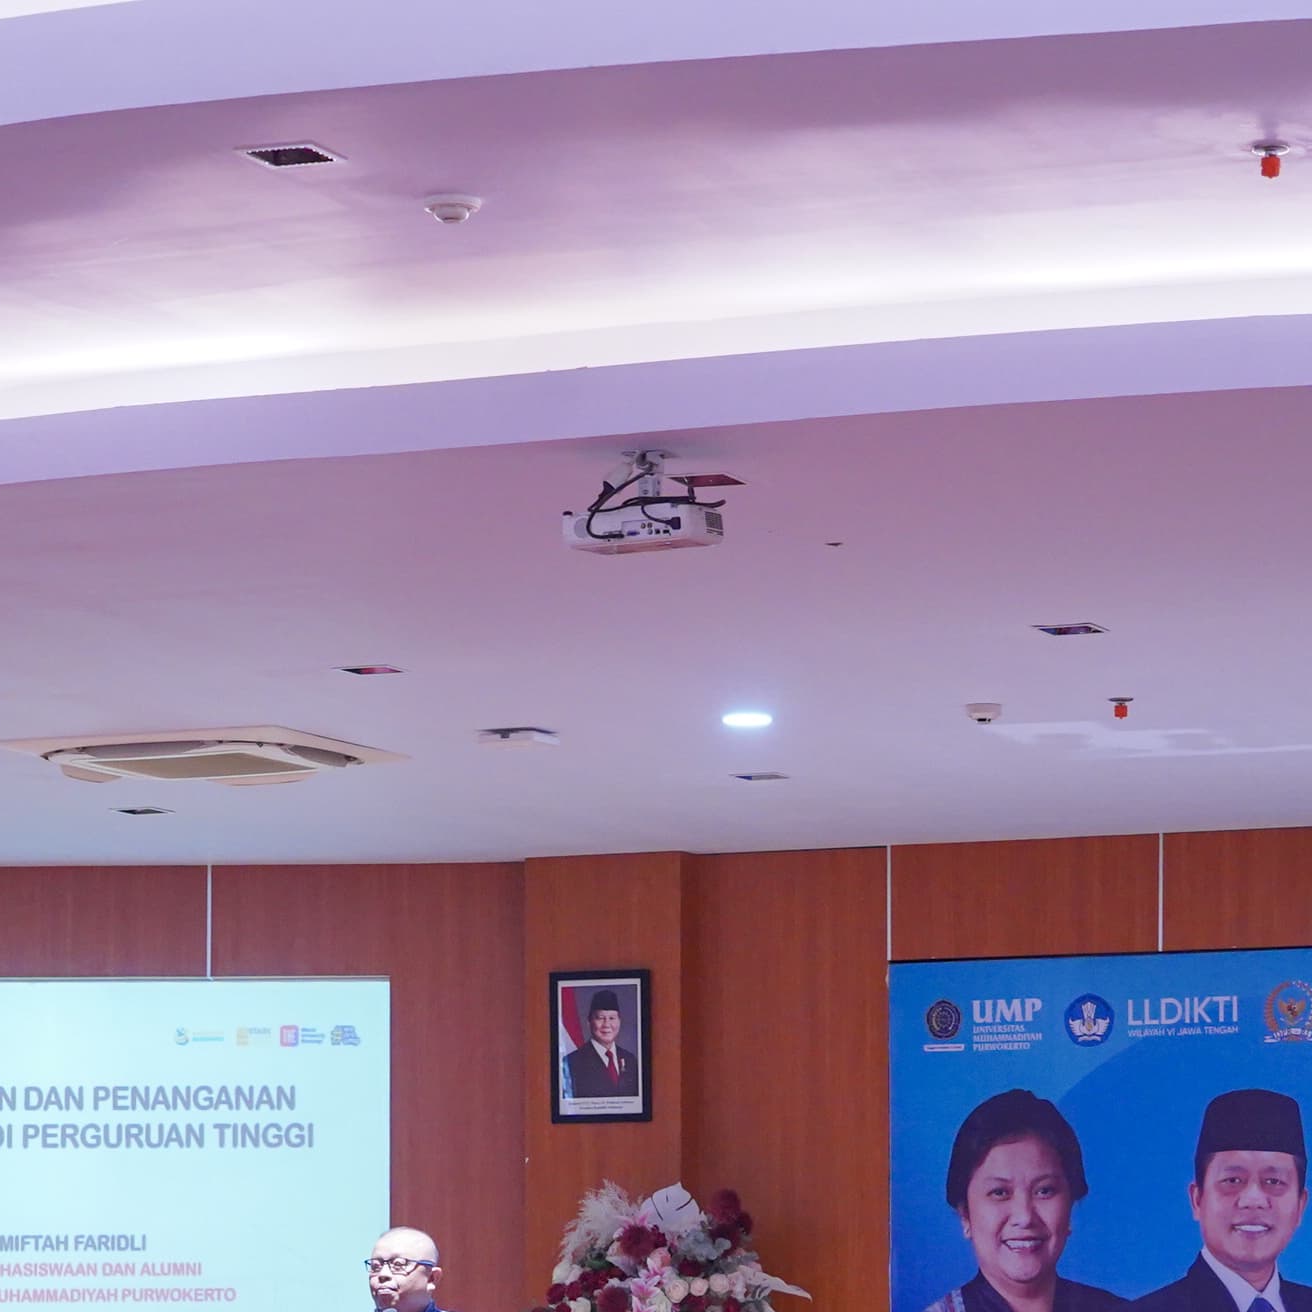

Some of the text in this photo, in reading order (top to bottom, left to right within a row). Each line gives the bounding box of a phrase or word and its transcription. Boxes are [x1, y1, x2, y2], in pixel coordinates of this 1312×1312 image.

[972, 998, 1042, 1024] UMP
[1128, 996, 1237, 1026] LLDIKTI
[973, 1024, 1024, 1034] UNIVERSITAS
[1128, 1028, 1165, 1037] WILAYAH
[1177, 1027, 1202, 1036] JAWA
[1204, 1026, 1238, 1034] TENGAH
[24, 1086, 84, 1112] DAN
[93, 1085, 296, 1111] PENANGANAN
[22, 1123, 204, 1149] PERGURUAN
[214, 1122, 314, 1148] TINGGI
[0, 1235, 68, 1252] MIFTAH
[74, 1234, 146, 1251] FARIDLI
[102, 1262, 136, 1276] DAN
[140, 1262, 202, 1276] ALUMNI
[122, 1288, 236, 1302] PURWOKERTO
